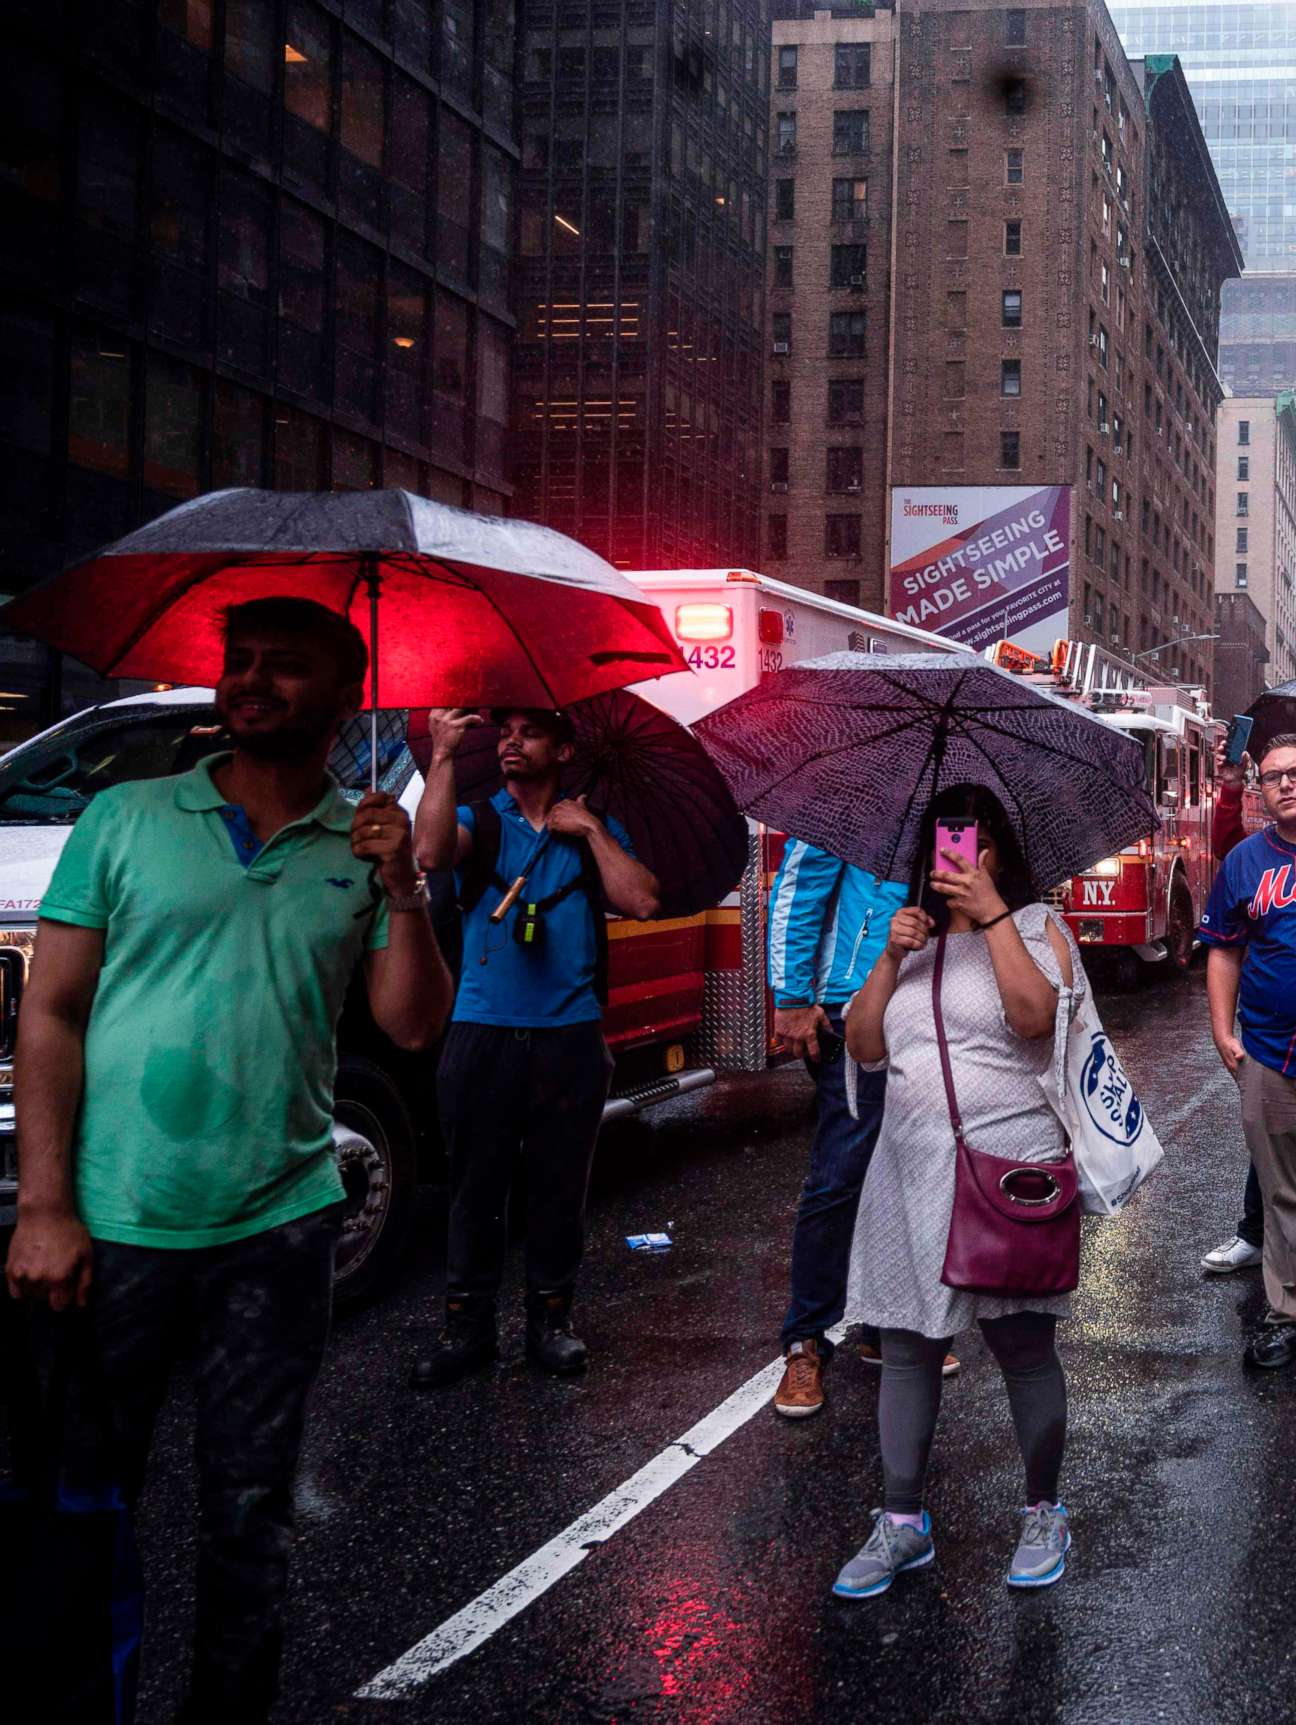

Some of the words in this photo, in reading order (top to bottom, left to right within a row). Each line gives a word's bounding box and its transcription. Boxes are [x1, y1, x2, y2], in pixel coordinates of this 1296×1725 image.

[903, 504, 959, 517] SIGHTSEEING
[942, 516, 959, 525] PASS
[903, 510, 1046, 595] SIGHTSEEING
[895, 578, 973, 625] MADE
[973, 529, 1065, 590] SIMPLE
[966, 621, 981, 633] pass
[1005, 590, 1038, 611] FAVORITE
[1037, 583, 1053, 595] CITY
[758, 647, 783, 673] 1432
[1082, 880, 1116, 905] N.Y.
